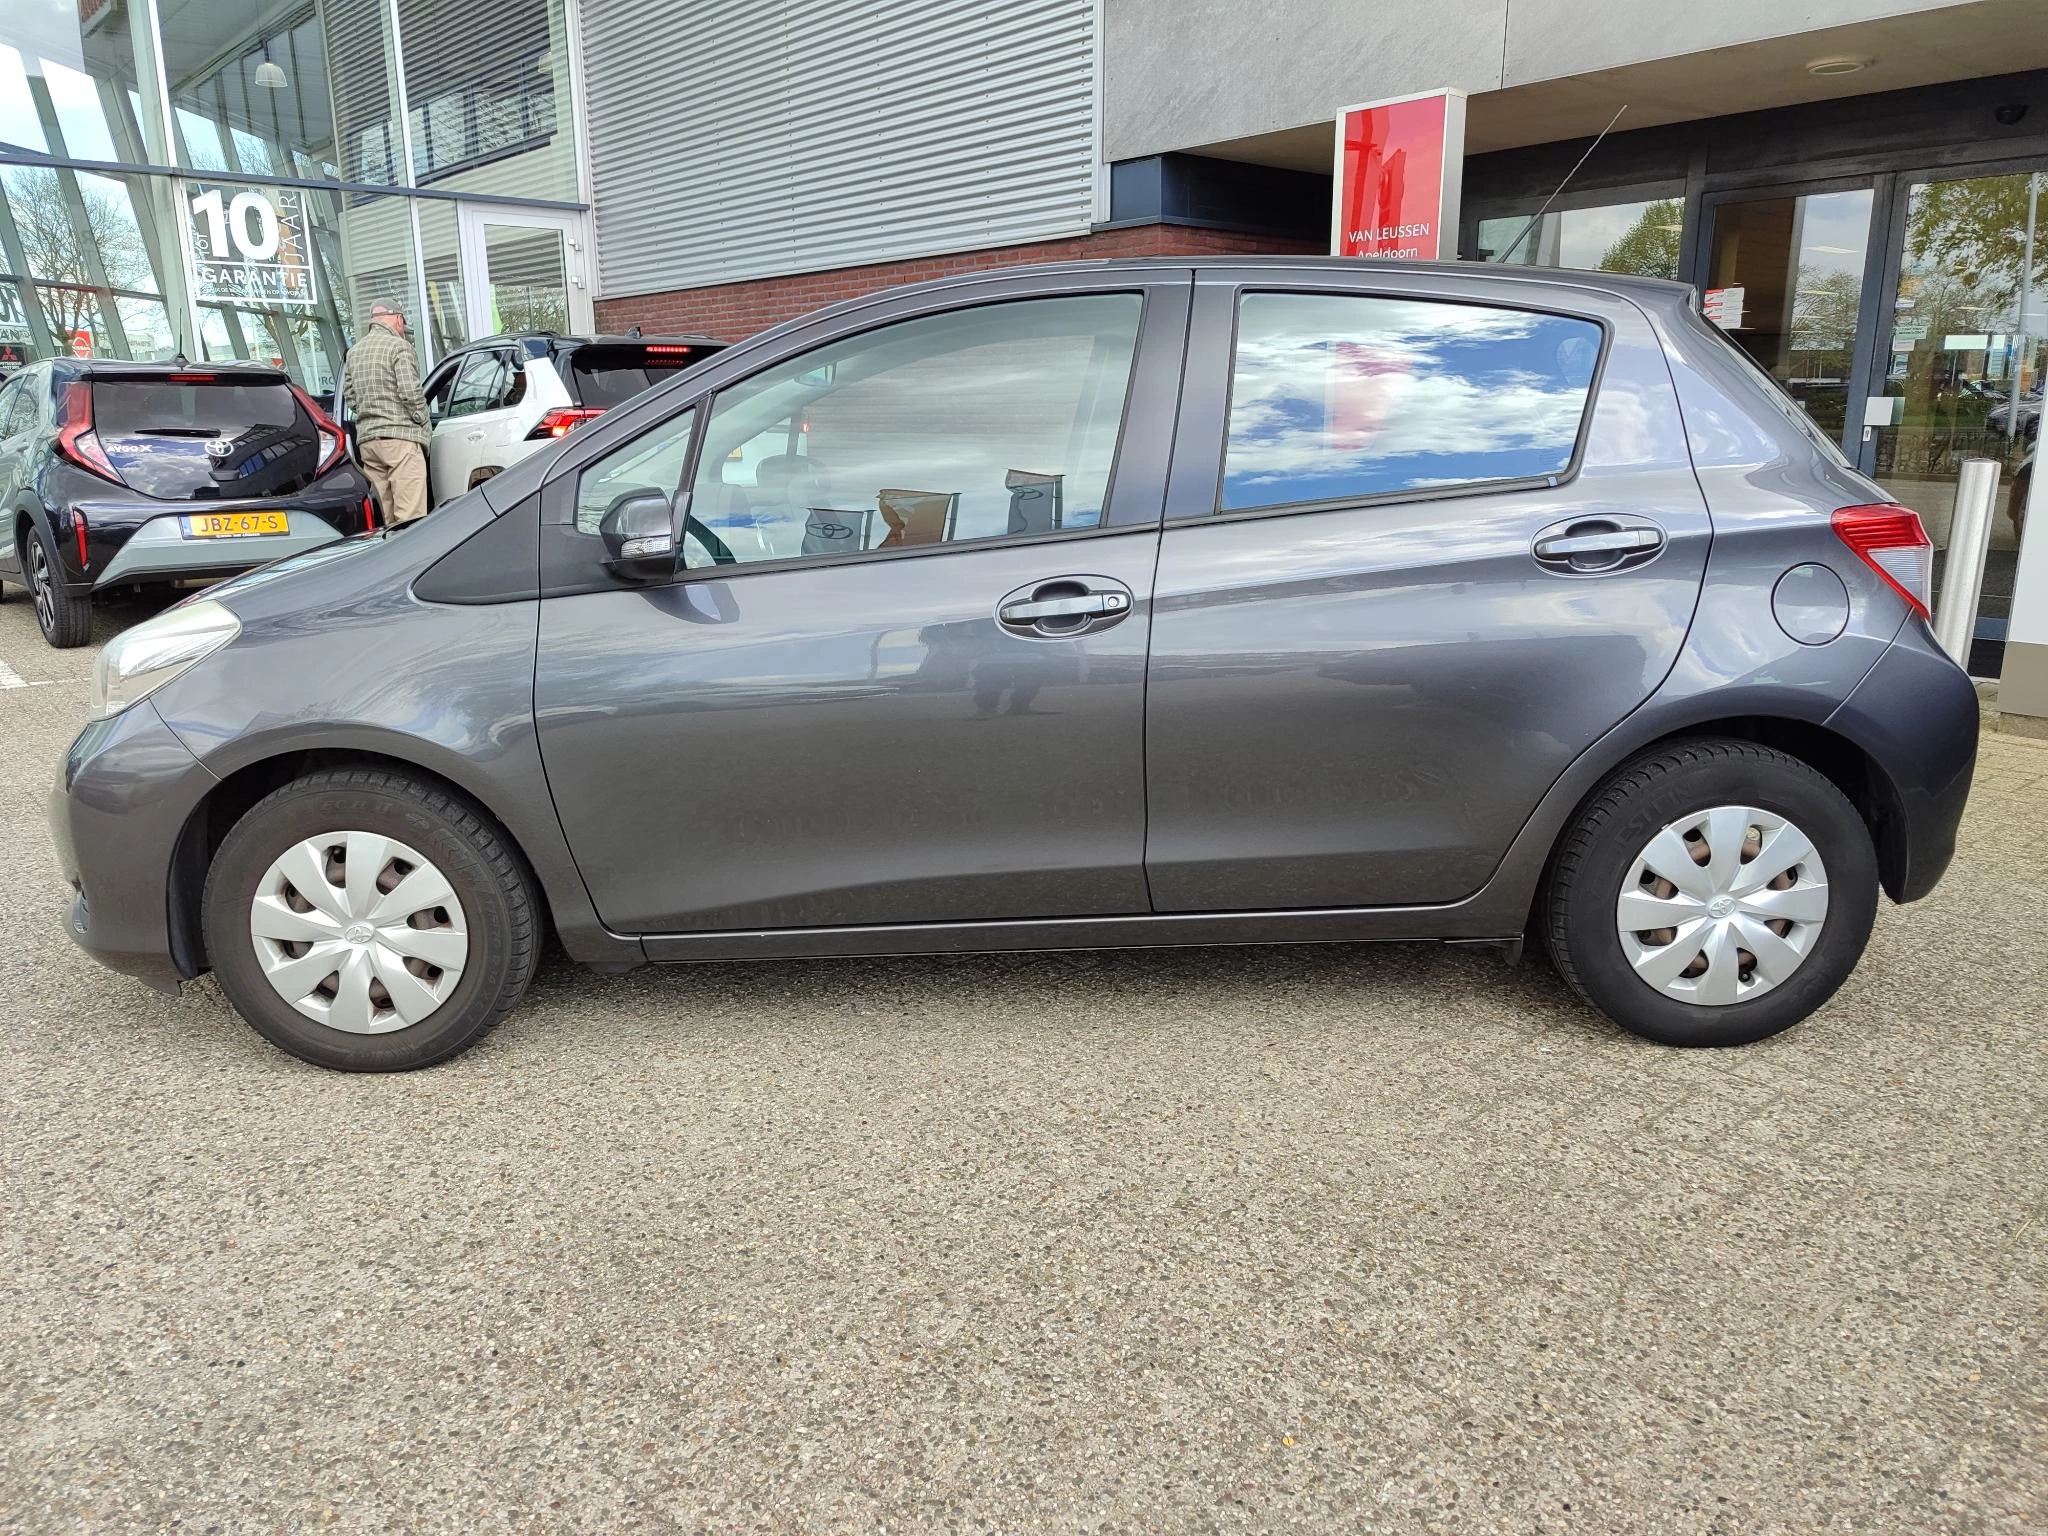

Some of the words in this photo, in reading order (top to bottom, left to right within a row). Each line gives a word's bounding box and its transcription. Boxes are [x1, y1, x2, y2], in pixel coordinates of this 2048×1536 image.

[192, 189, 279, 260] 10
[278, 190, 305, 263] JAAR
[1349, 229, 1373, 243] VAN
[1376, 223, 1430, 240] LEUSSEN
[201, 268, 307, 288] GARANTIE
[201, 515, 278, 532] JBZ-67-S
